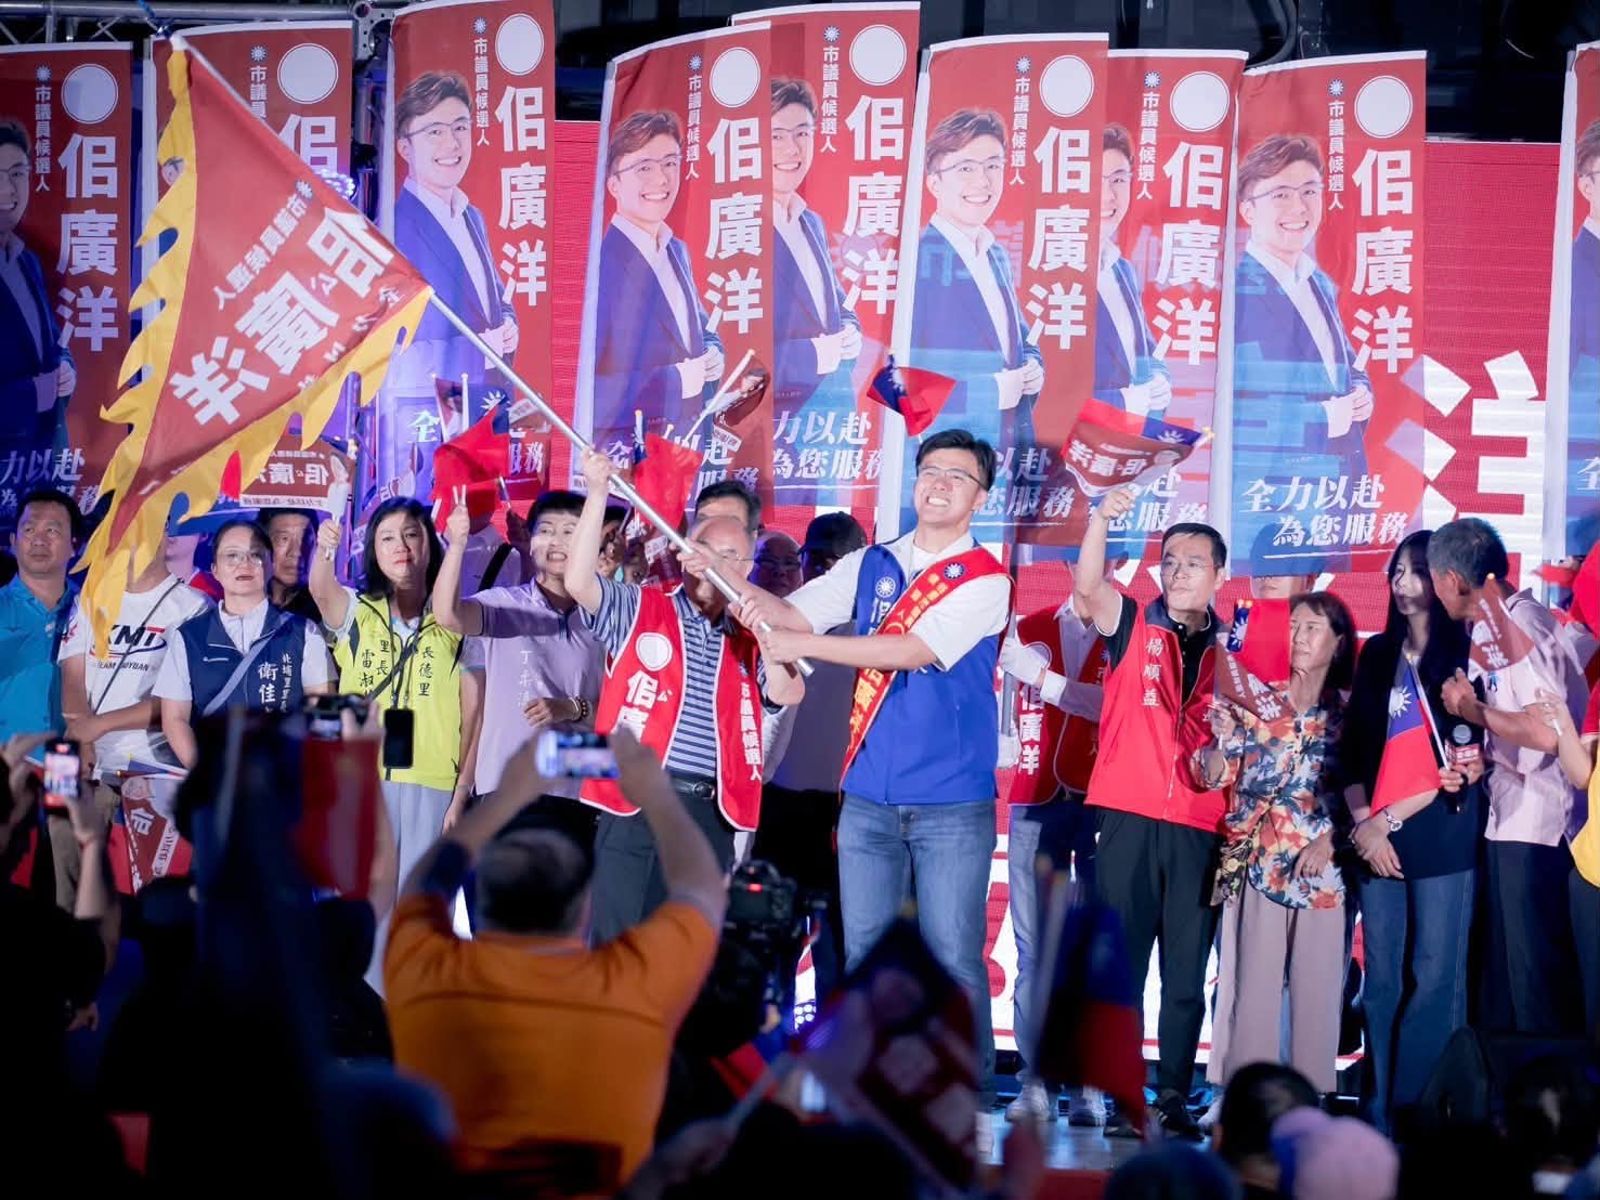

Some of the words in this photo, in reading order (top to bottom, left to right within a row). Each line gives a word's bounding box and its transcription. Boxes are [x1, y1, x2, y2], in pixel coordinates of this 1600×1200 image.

[36, 87, 51, 192] 市議員候選人
[474, 38, 489, 146] 市議員候選人
[685, 75, 702, 180] 市議員候選人
[821, 45, 838, 153] 市議員候選人
[1010, 78, 1031, 184] 市議員候選人
[1137, 92, 1160, 200] 市議員候選人
[1328, 101, 1344, 210] 市議員候選人
[1239, 474, 1385, 513] 全力以赴
[1273, 512, 1408, 547] 為您服務
[258, 661, 278, 713] 衛佳
[360, 649, 375, 696] 雷淑
[419, 646, 434, 696] 長德里
